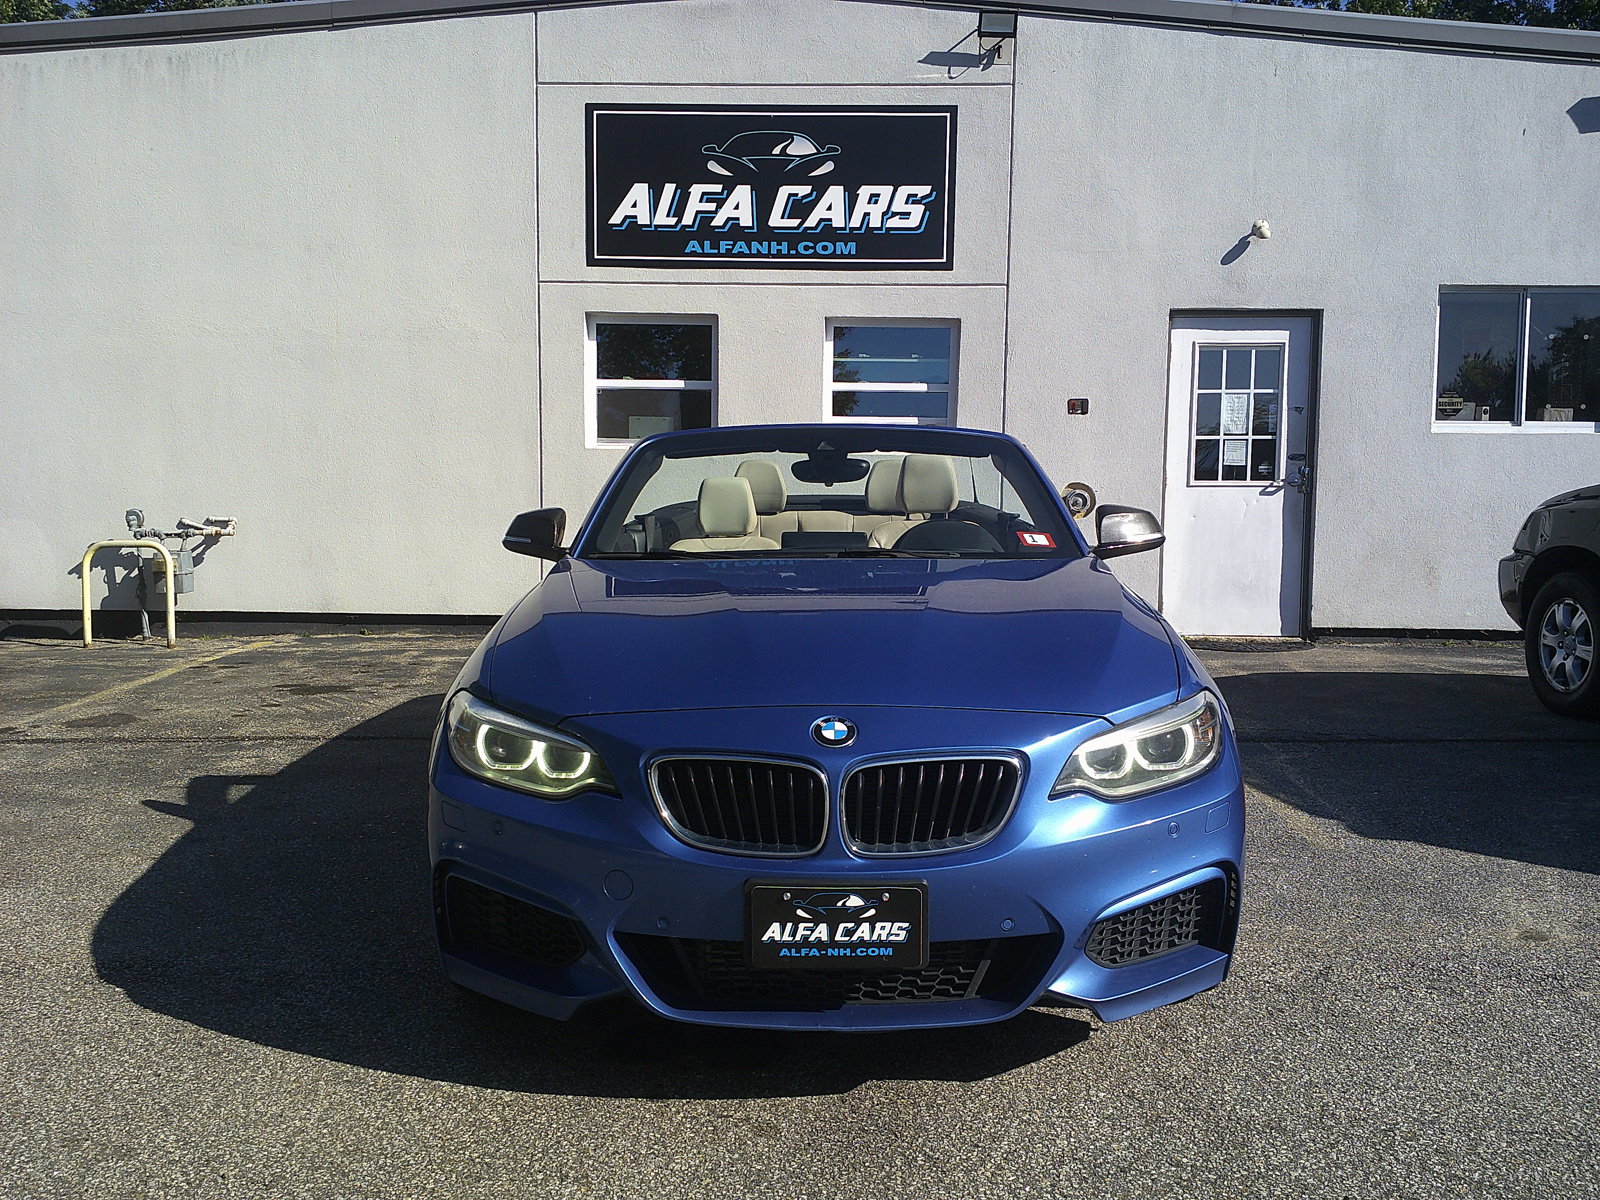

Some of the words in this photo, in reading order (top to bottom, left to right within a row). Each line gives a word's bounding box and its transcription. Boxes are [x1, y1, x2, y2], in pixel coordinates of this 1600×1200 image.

[608, 183, 757, 231] ALFA
[767, 185, 936, 234] CARS
[685, 240, 857, 255] ALFANH.COM
[1029, 535, 1038, 543] 1
[761, 922, 830, 943] ALFA
[834, 922, 911, 943] CARS
[779, 947, 893, 957] ALFA-NH.COM
